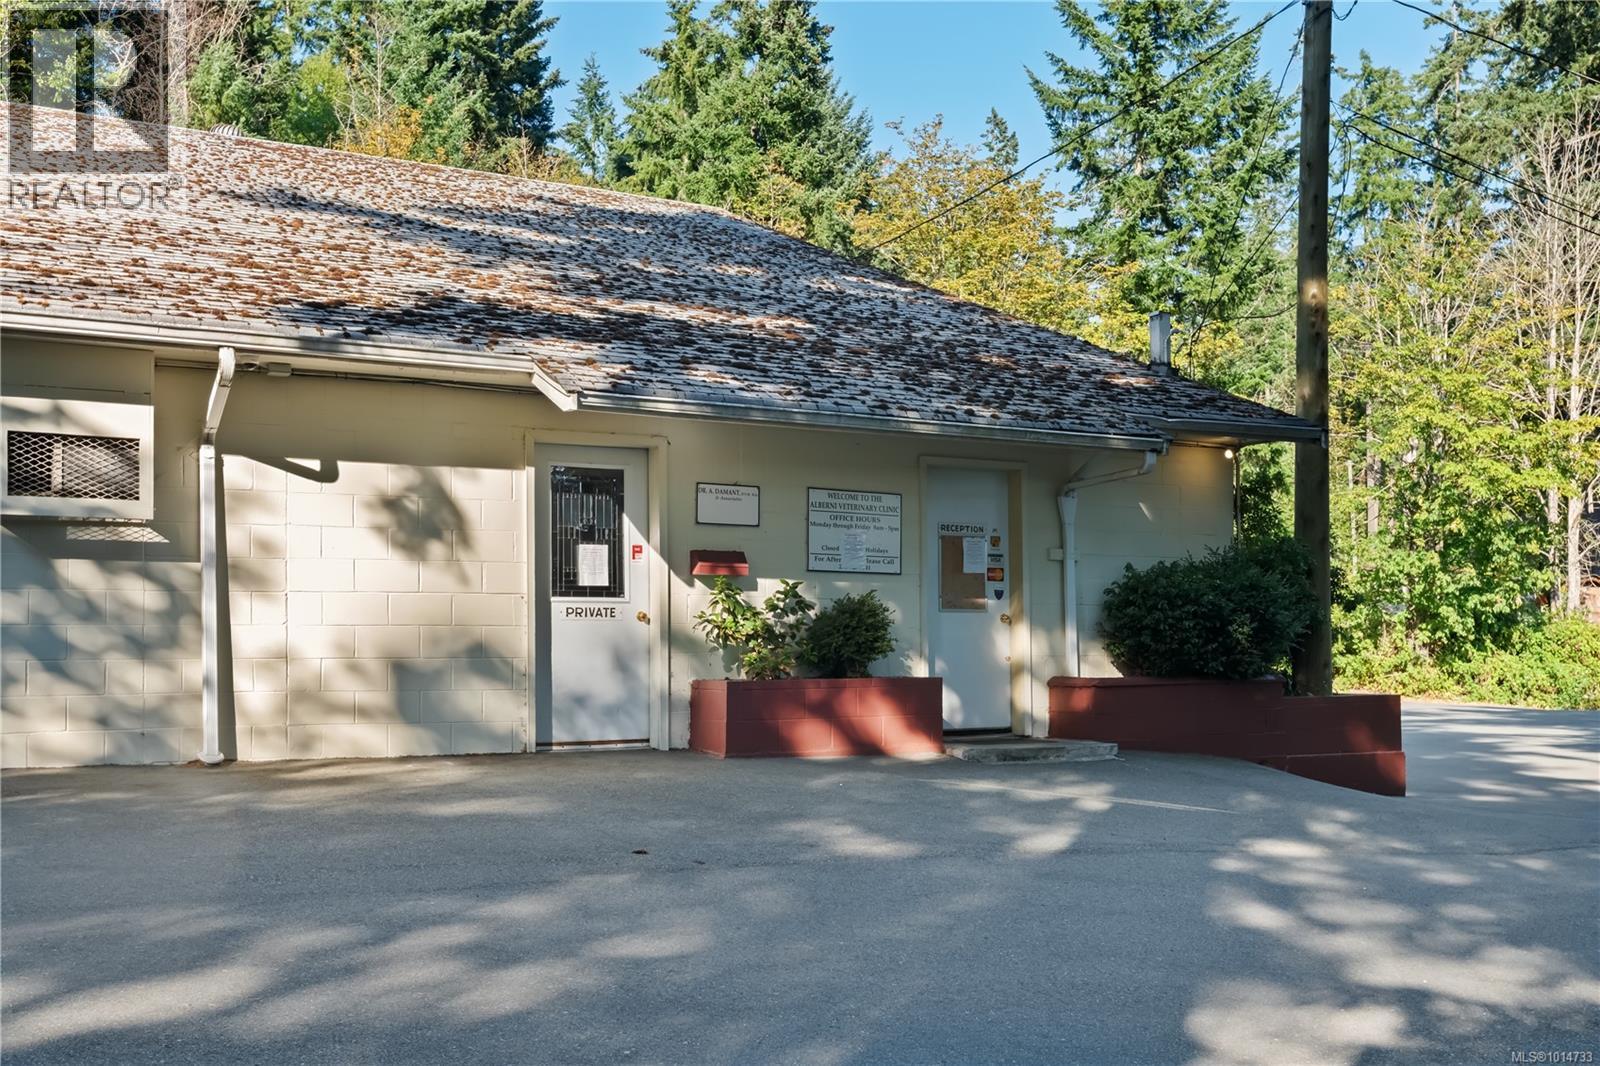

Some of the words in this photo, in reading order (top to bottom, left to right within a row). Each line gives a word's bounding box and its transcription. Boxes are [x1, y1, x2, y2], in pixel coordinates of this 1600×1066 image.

[828, 492, 859, 500] WELCOME
[810, 501, 838, 509] ALBERNI
[838, 503, 877, 512] VETERINARY
[810, 521, 831, 529] Monday
[940, 524, 984, 533] RECEPTION
[566, 607, 616, 618] PRIVATE
